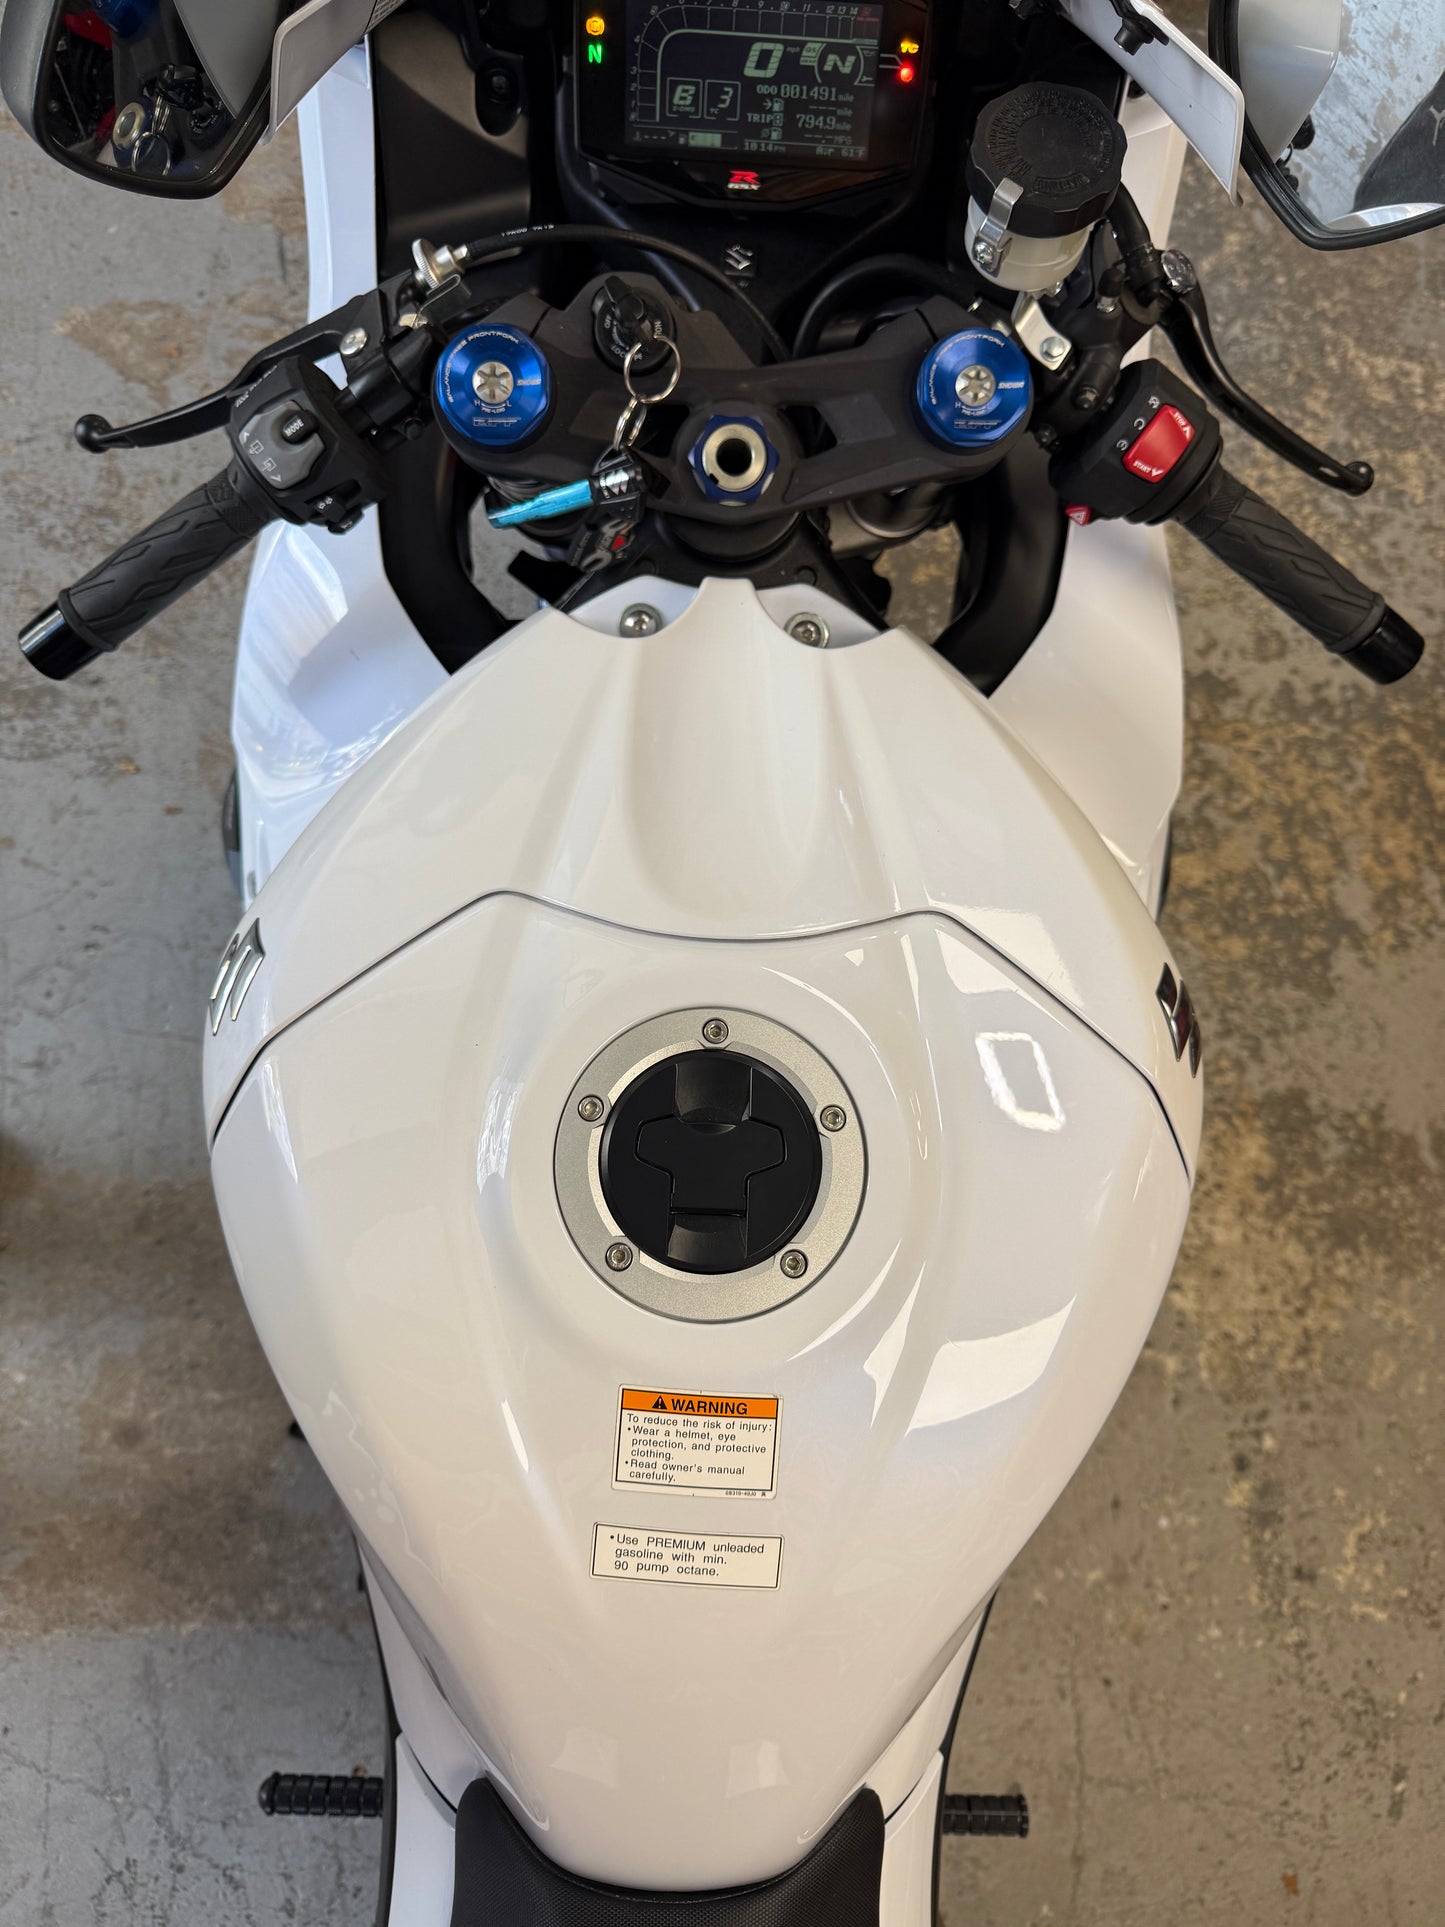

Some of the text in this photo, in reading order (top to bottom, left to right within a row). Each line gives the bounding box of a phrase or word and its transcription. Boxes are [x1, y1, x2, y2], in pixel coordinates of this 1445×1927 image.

[802, 3, 812, 12] 11
[826, 5, 835, 14] 12
[837, 6, 847, 15] 13
[588, 44, 602, 63] N
[743, 42, 784, 78] 0
[823, 54, 856, 74] N
[718, 87, 734, 108] 3
[756, 84, 778, 95] ODO
[780, 84, 837, 101] 001491
[284, 419, 305, 437] MODE
[671, 1398, 748, 1415] WARNING
[626, 1413, 772, 1433] To reduce the risk of injury:
[664, 1429, 671, 1437] a
[675, 1429, 713, 1441] helmet,
[717, 1432, 736, 1442] eye
[631, 1437, 767, 1454] protection, and protective
[630, 1448, 674, 1461] clothing.
[629, 1470, 676, 1483] carefully.
[662, 1463, 703, 1473] owner's
[707, 1465, 745, 1475] manual
[616, 1533, 765, 1554] Use PREMIUM unleaded
[615, 1547, 727, 1565] gasoline with min.
[614, 1560, 720, 1576] 90 pump octane.
